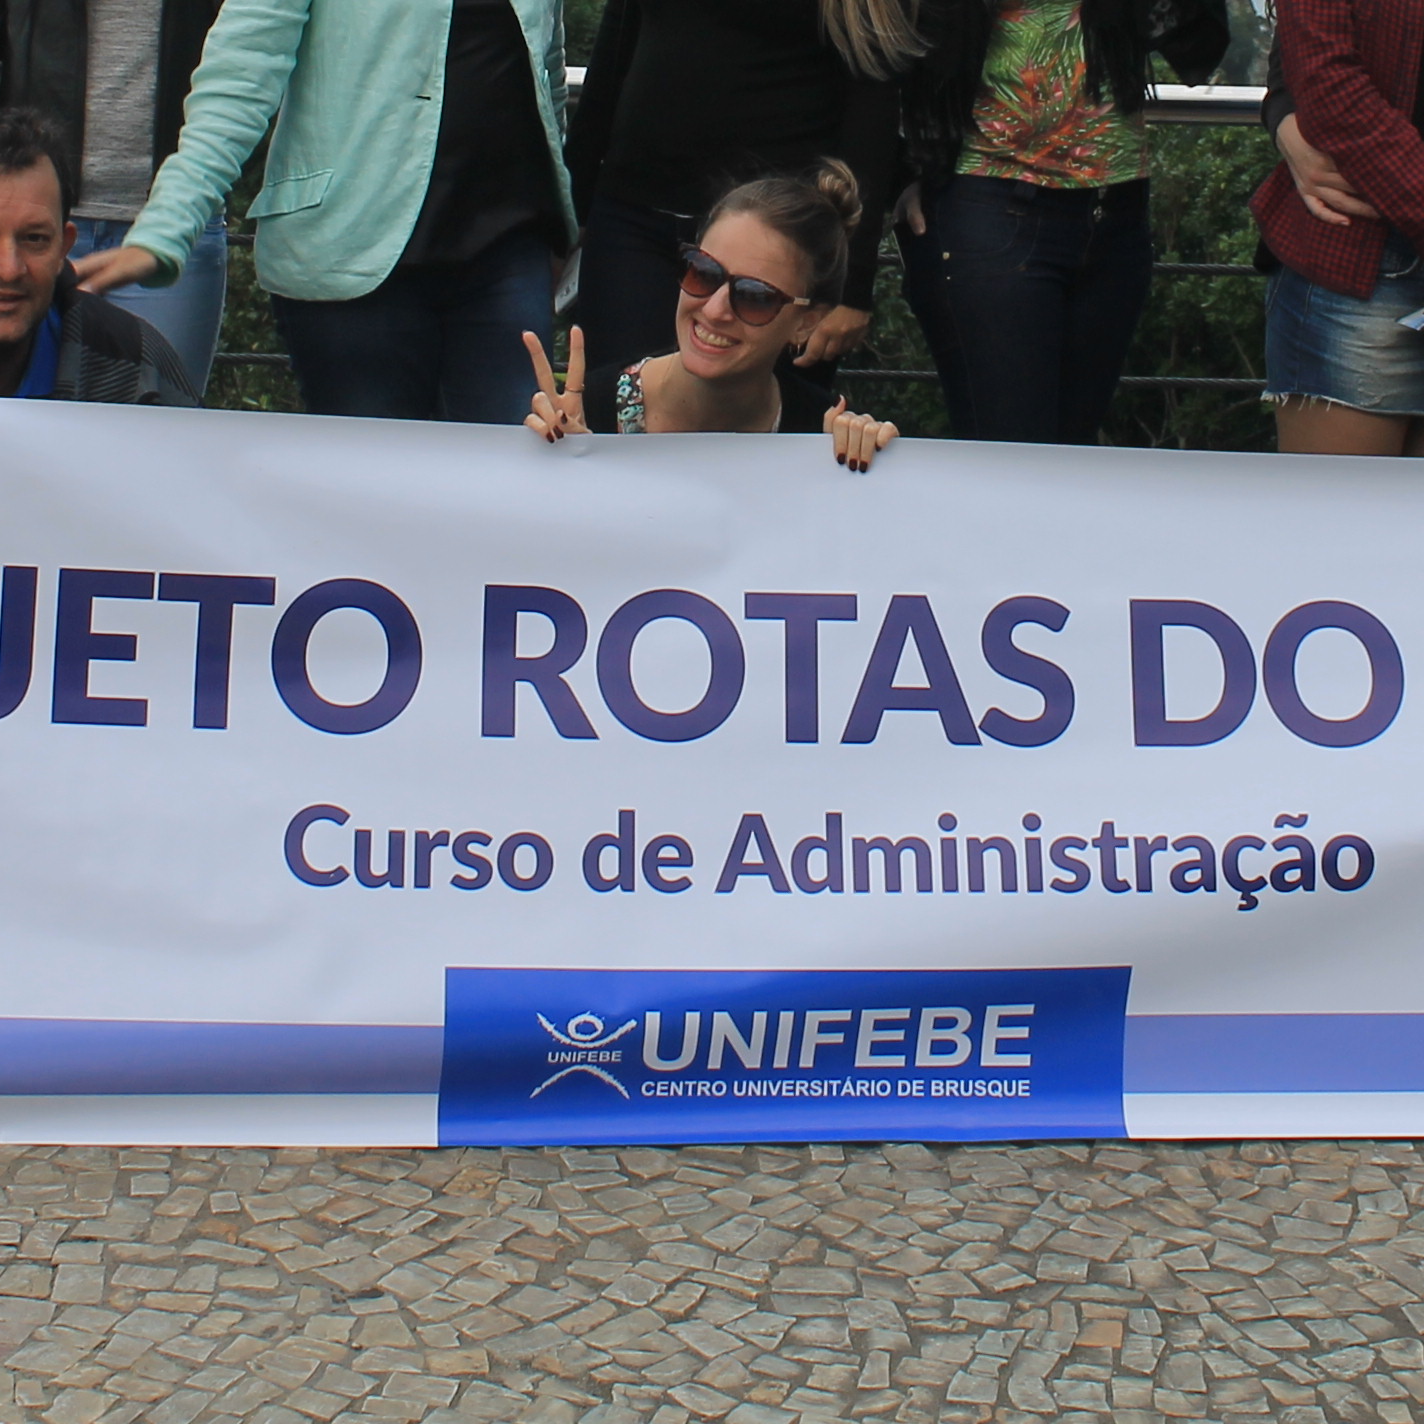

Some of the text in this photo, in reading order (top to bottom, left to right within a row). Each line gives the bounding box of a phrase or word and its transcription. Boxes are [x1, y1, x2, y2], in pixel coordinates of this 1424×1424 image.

[480, 583, 1076, 748] ROTAS
[1129, 598, 1405, 749] DO
[283, 803, 1376, 912] Curso de Administração
[547, 1051, 623, 1063] UNIFEBE
[643, 1005, 1035, 1071] UNIFEBE
[641, 1077, 1030, 1098] CENTRO UNIVERSITÁRIO DE BRUSQUE
